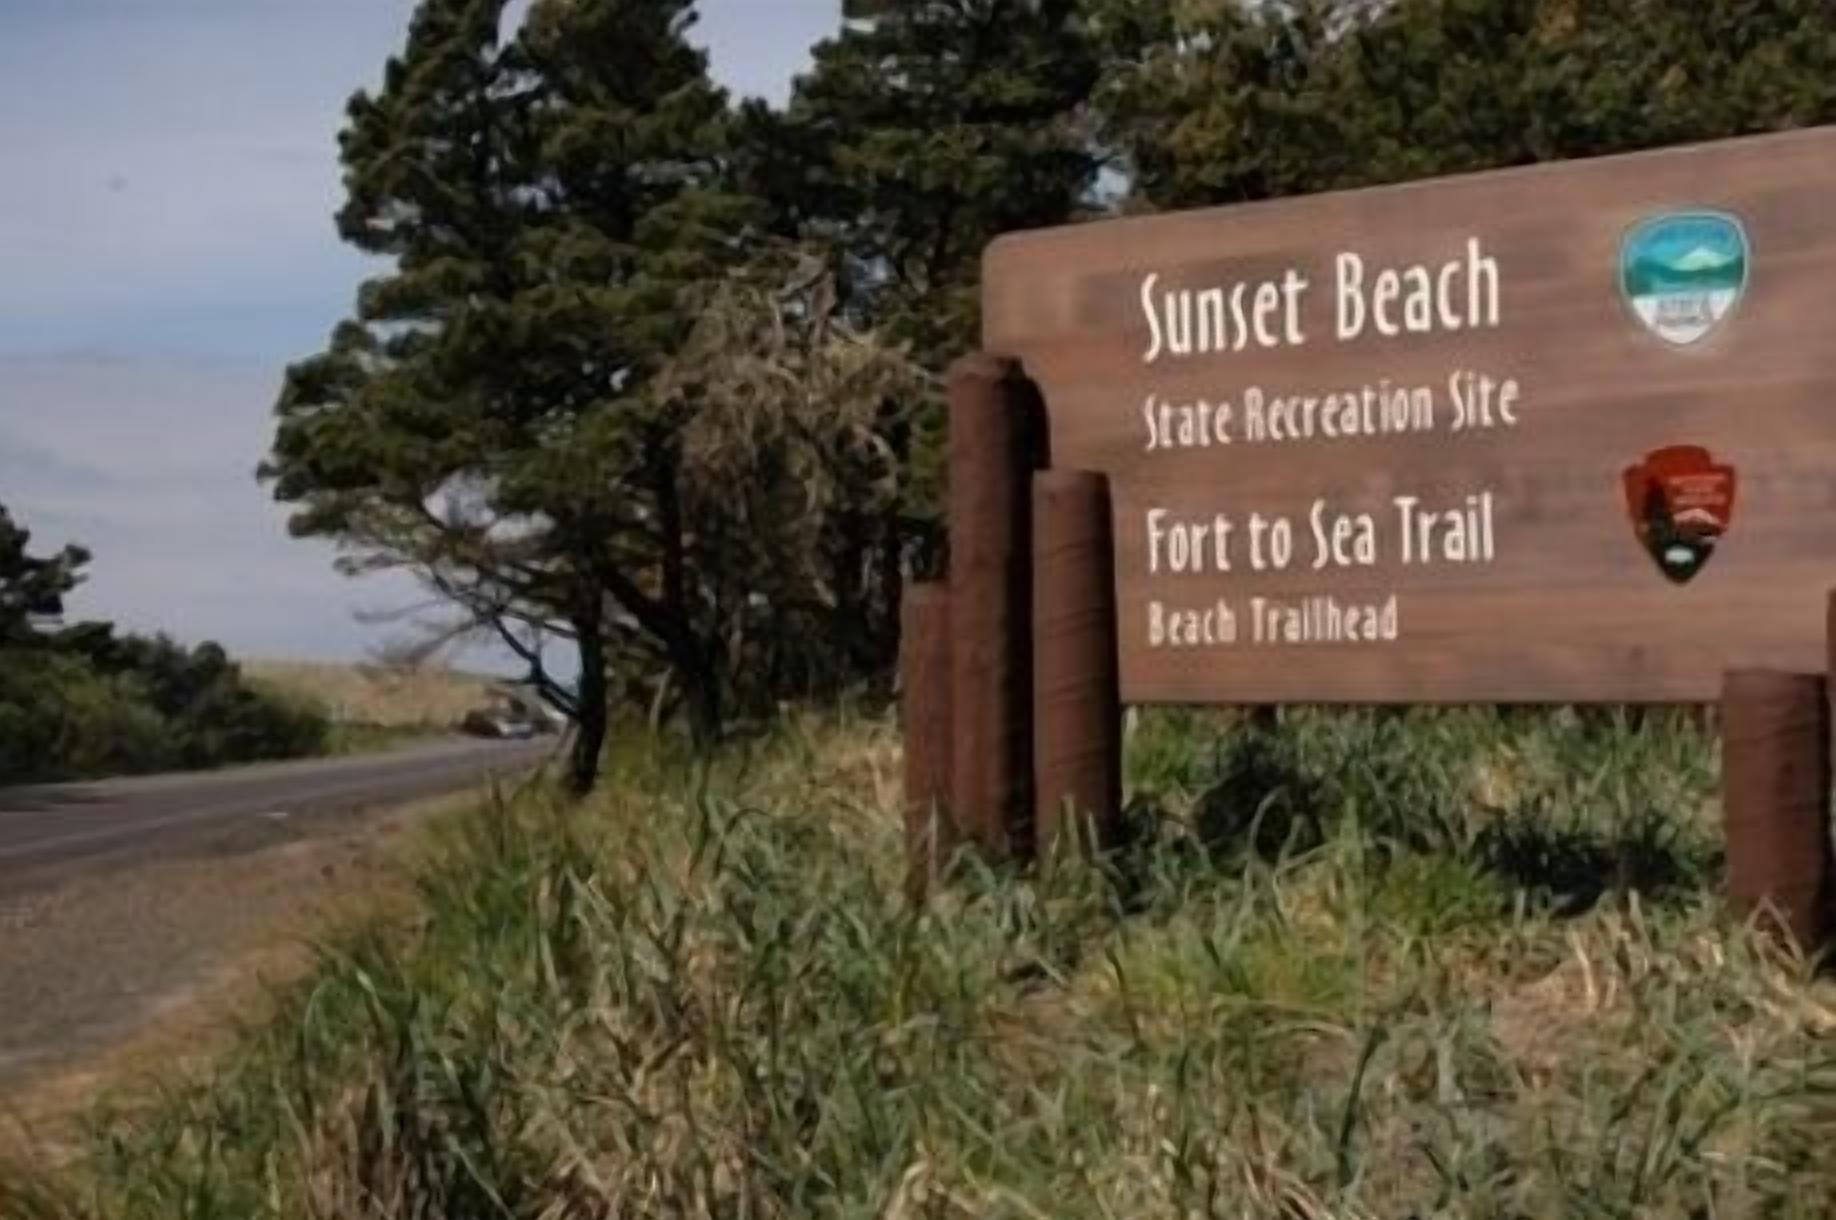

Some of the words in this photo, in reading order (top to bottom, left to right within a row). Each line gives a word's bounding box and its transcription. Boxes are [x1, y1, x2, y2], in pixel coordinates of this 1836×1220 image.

[1141, 269, 1307, 363] Sunset
[1336, 236, 1499, 340] Beach
[1144, 393, 1233, 452] State
[1245, 379, 1433, 442] Recreation
[1449, 369, 1519, 432] Site
[1147, 508, 1234, 573] Fort
[1250, 512, 1291, 570] to
[1311, 498, 1376, 570] Sea
[1394, 492, 1495, 565] Trail
[1149, 598, 1236, 646] Beach
[1251, 594, 1398, 642] Trailhead
